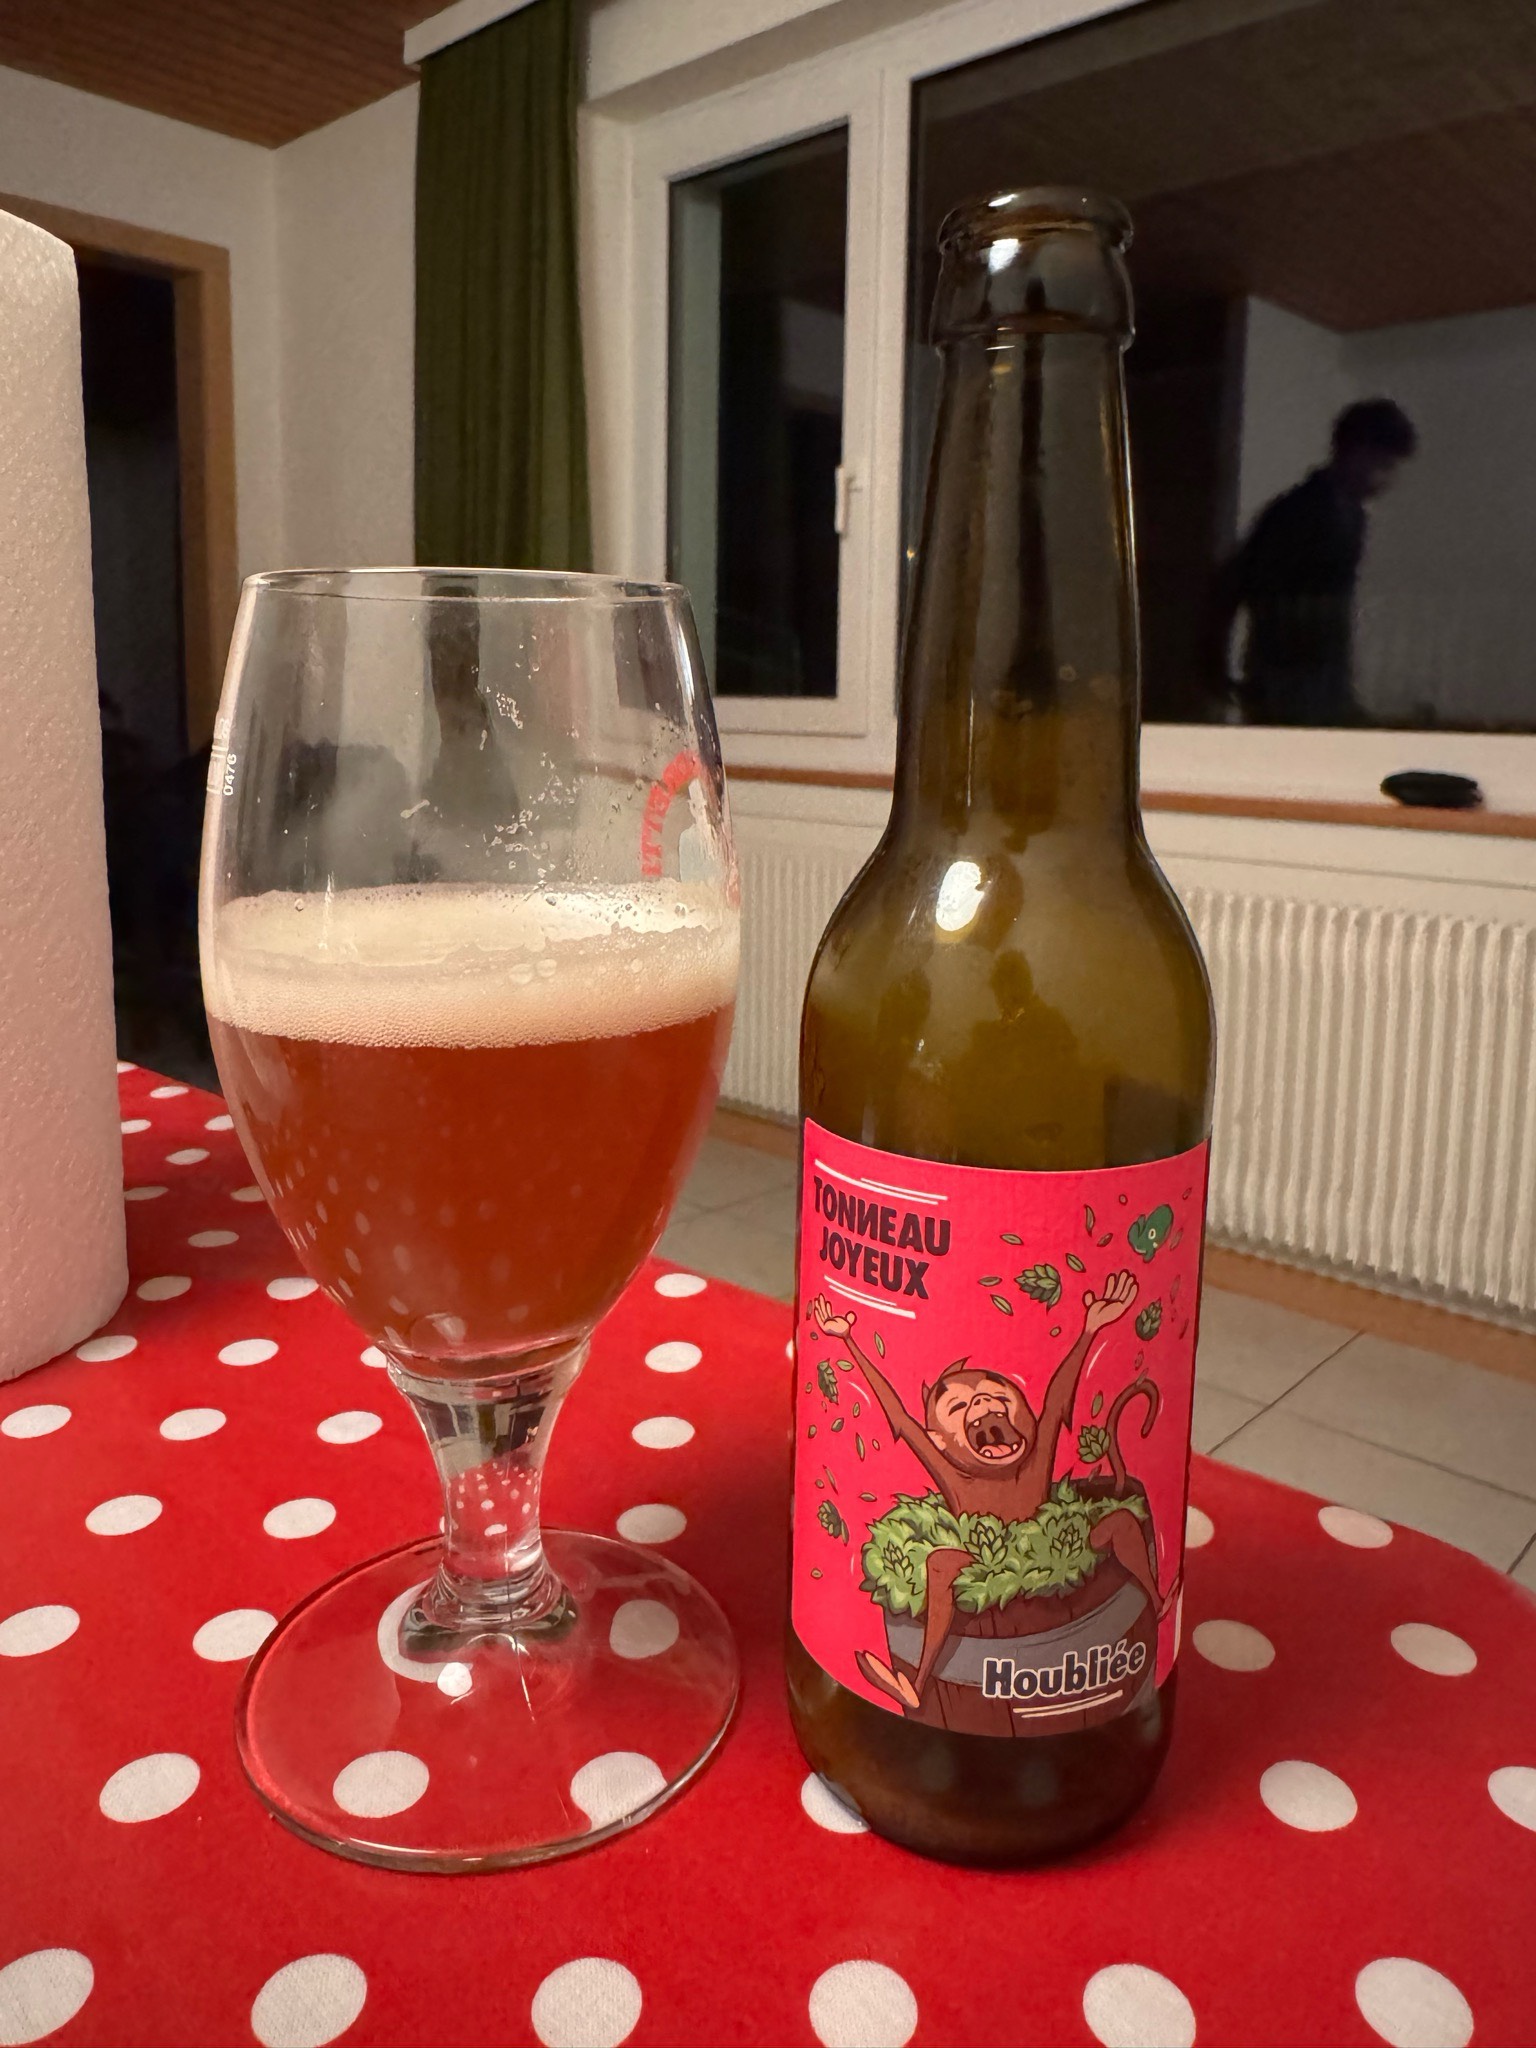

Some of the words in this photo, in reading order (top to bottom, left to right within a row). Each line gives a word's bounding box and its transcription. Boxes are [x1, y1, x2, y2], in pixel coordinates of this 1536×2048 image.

[223, 753, 237, 796] 0476
[819, 1226, 930, 1300] JOYEUX
[982, 1638, 1147, 1700] Houbliée
